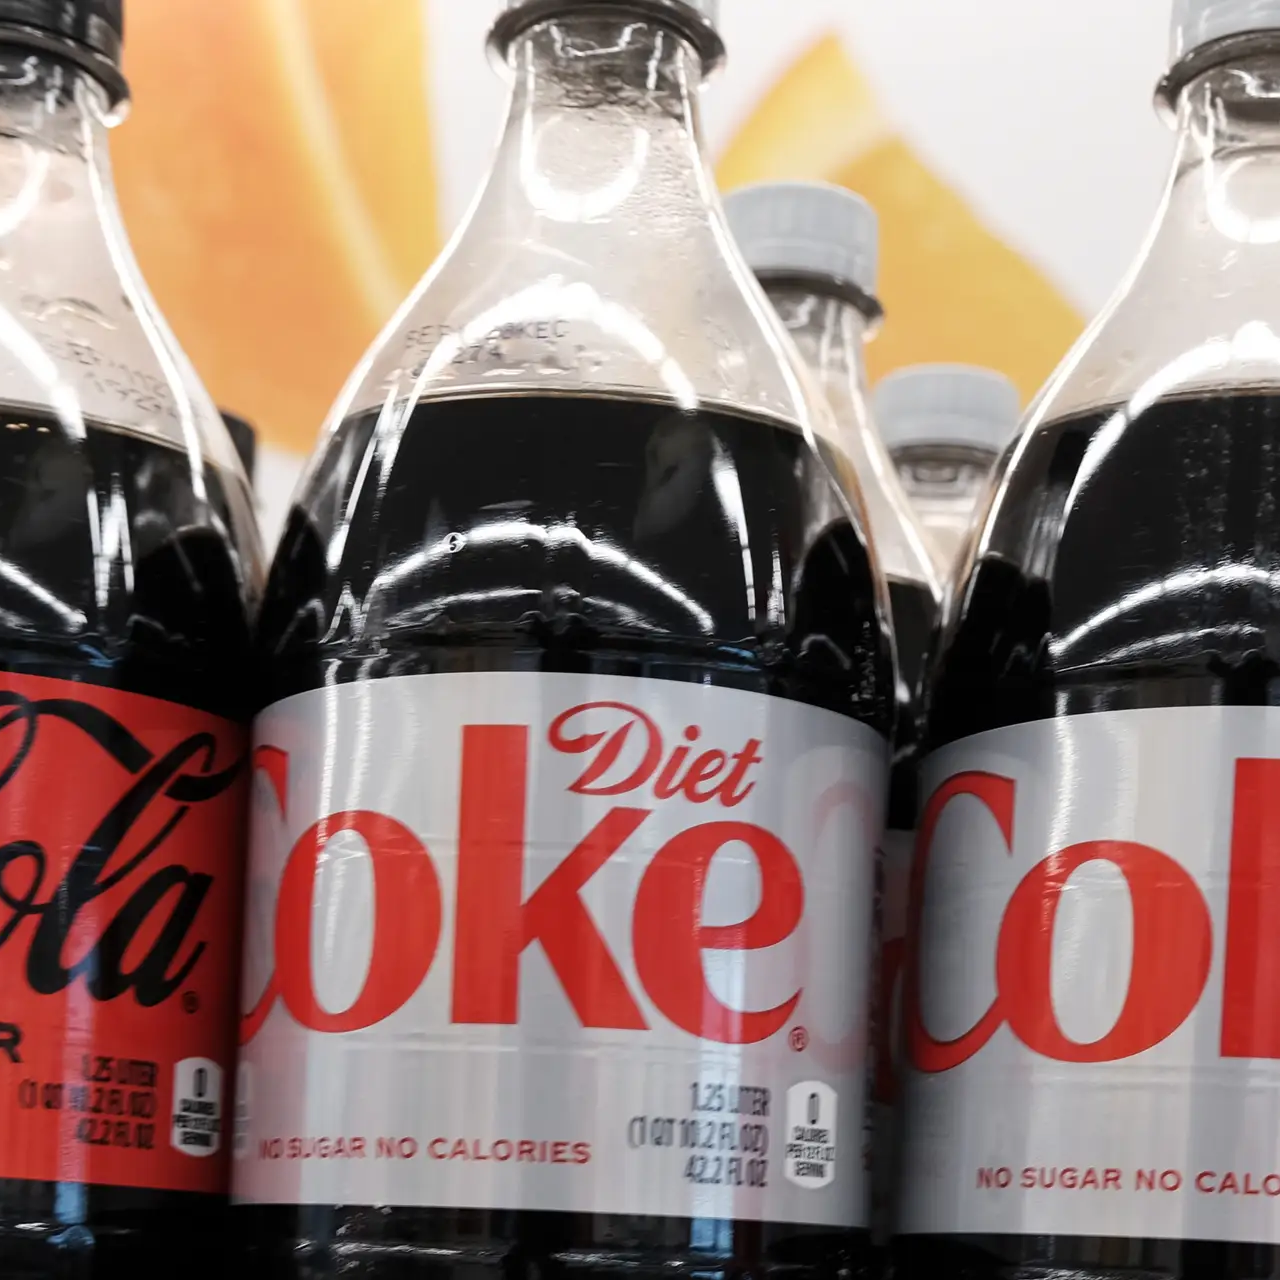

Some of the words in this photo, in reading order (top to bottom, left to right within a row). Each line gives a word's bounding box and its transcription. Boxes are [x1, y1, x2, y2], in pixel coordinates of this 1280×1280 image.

[548, 701, 762, 807] Diet
[689, 1081, 725, 1113] 1.25
[375, 1136, 419, 1160] NO
[425, 1137, 593, 1165] CALORIES
[683, 1152, 723, 1185] 42.2
[976, 1165, 1014, 1190] NO
[1020, 1166, 1123, 1191] SUGAR
[1133, 1168, 1184, 1193] NO
